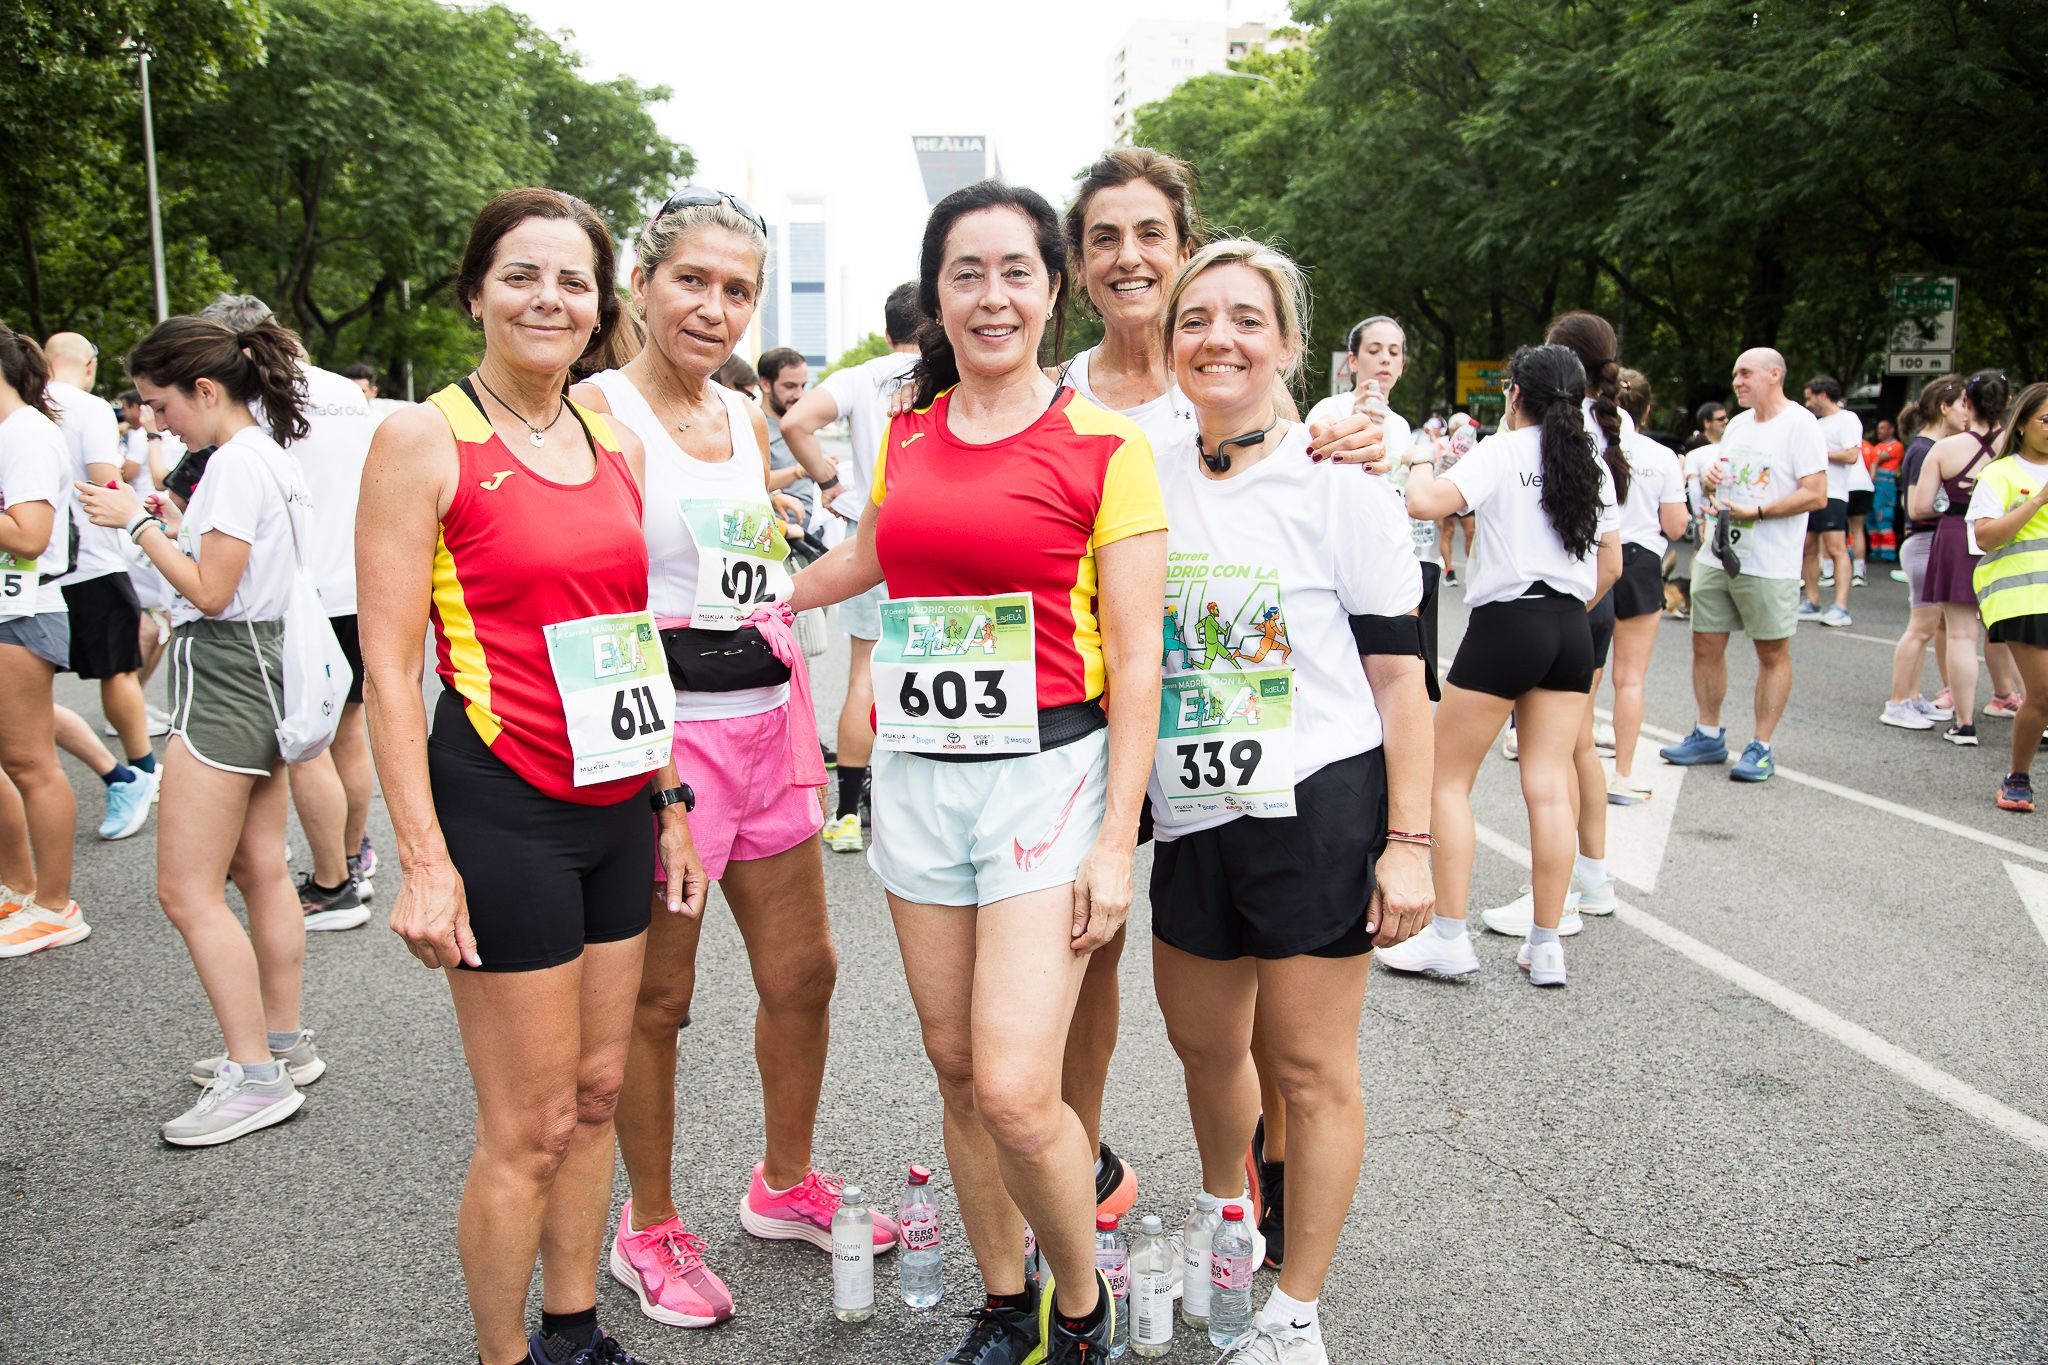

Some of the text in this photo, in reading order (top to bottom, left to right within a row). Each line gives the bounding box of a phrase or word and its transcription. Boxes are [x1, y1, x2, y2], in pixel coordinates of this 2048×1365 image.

[915, 136, 983, 152] REALIA
[1900, 357, 1941, 369] 100 m
[1168, 552, 1209, 561] Carrera
[1166, 565, 1279, 580] ADRID CON LA
[0, 574, 21, 597] 5
[907, 605, 945, 614] MADRID
[947, 605, 970, 613] CON
[971, 605, 985, 613] LA
[900, 670, 1007, 719] 603
[611, 685, 666, 740] 611
[580, 763, 610, 773] MUKUA
[1176, 740, 1262, 789] 339
[908, 1234, 934, 1242] SODIO
[909, 1228, 933, 1237] ZERO
